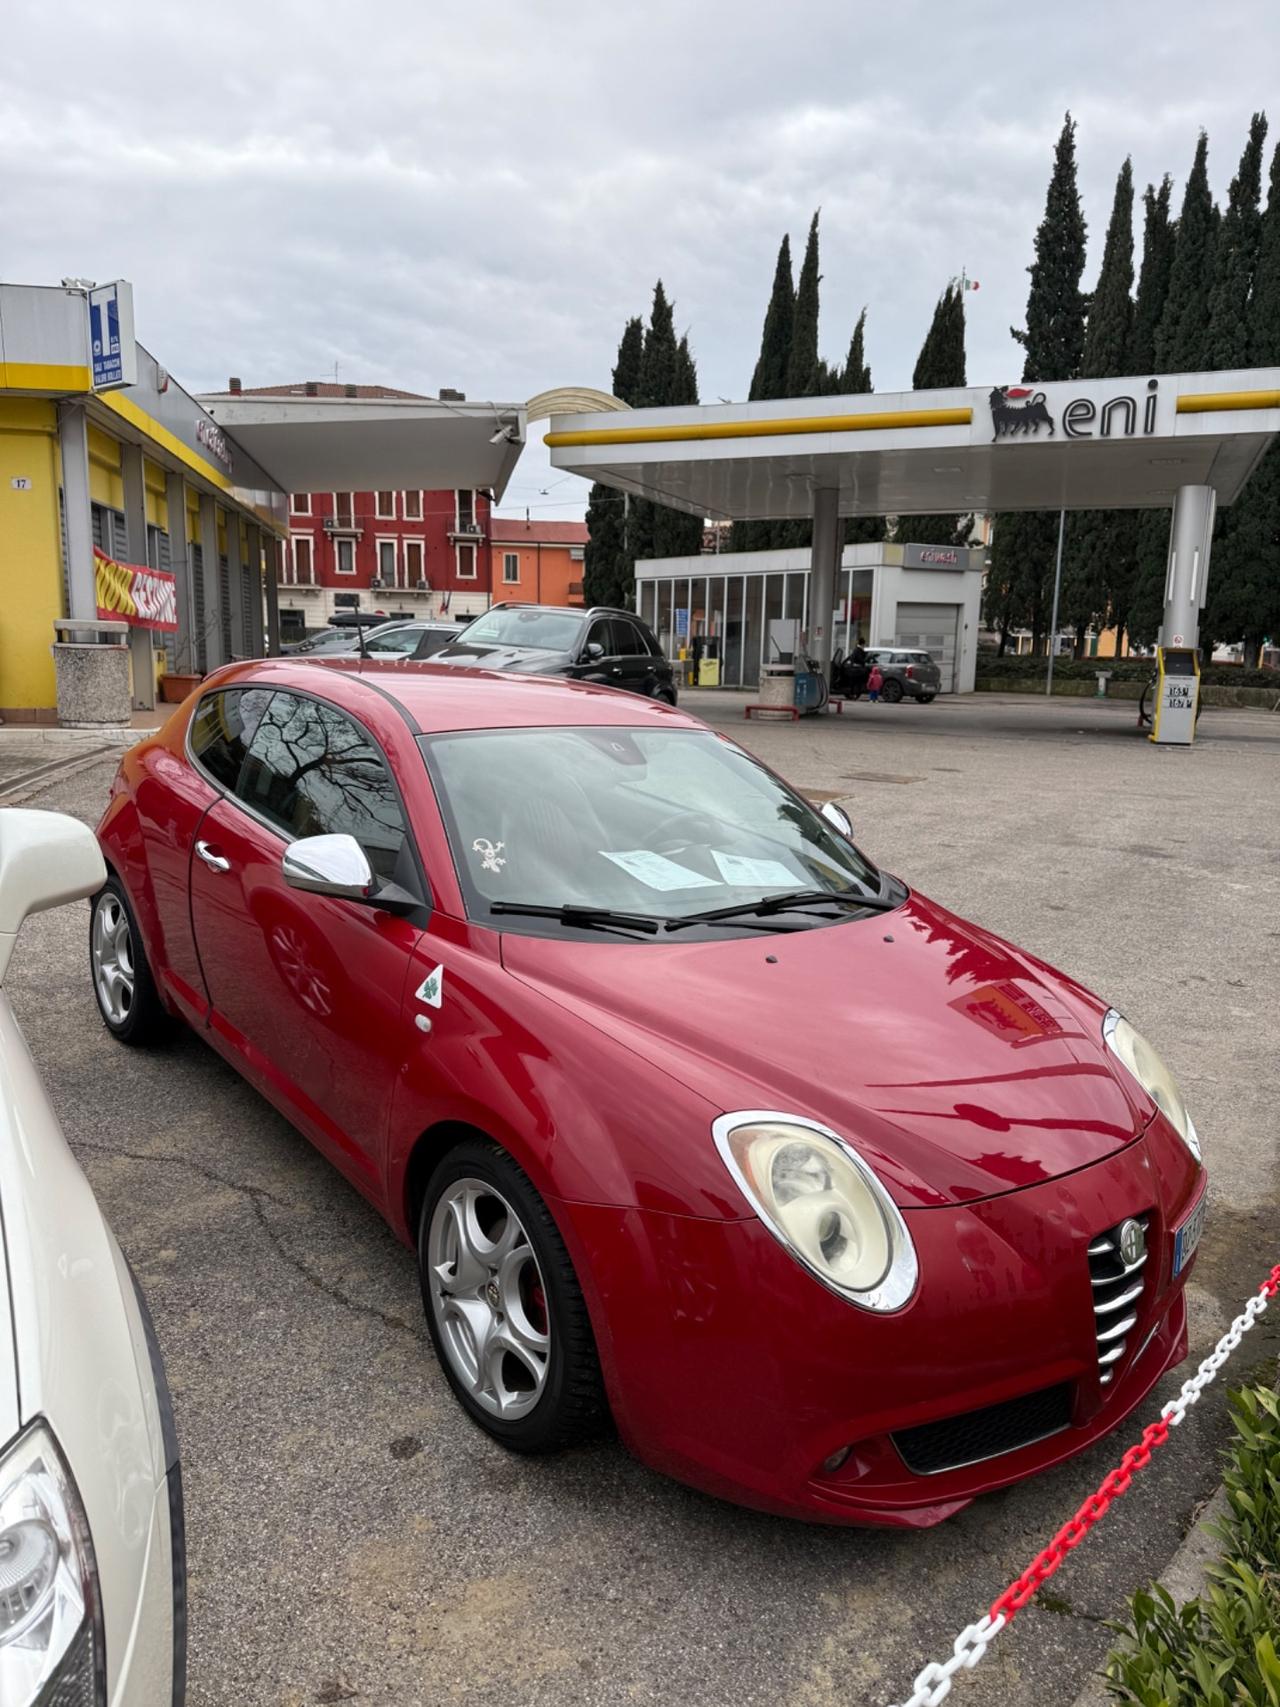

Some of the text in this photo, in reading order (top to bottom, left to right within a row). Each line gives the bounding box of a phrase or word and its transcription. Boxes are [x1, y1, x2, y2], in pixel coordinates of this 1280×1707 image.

[1062, 379, 1159, 438] eni
[17, 479, 26, 489] 17
[95, 557, 137, 617] NOVA
